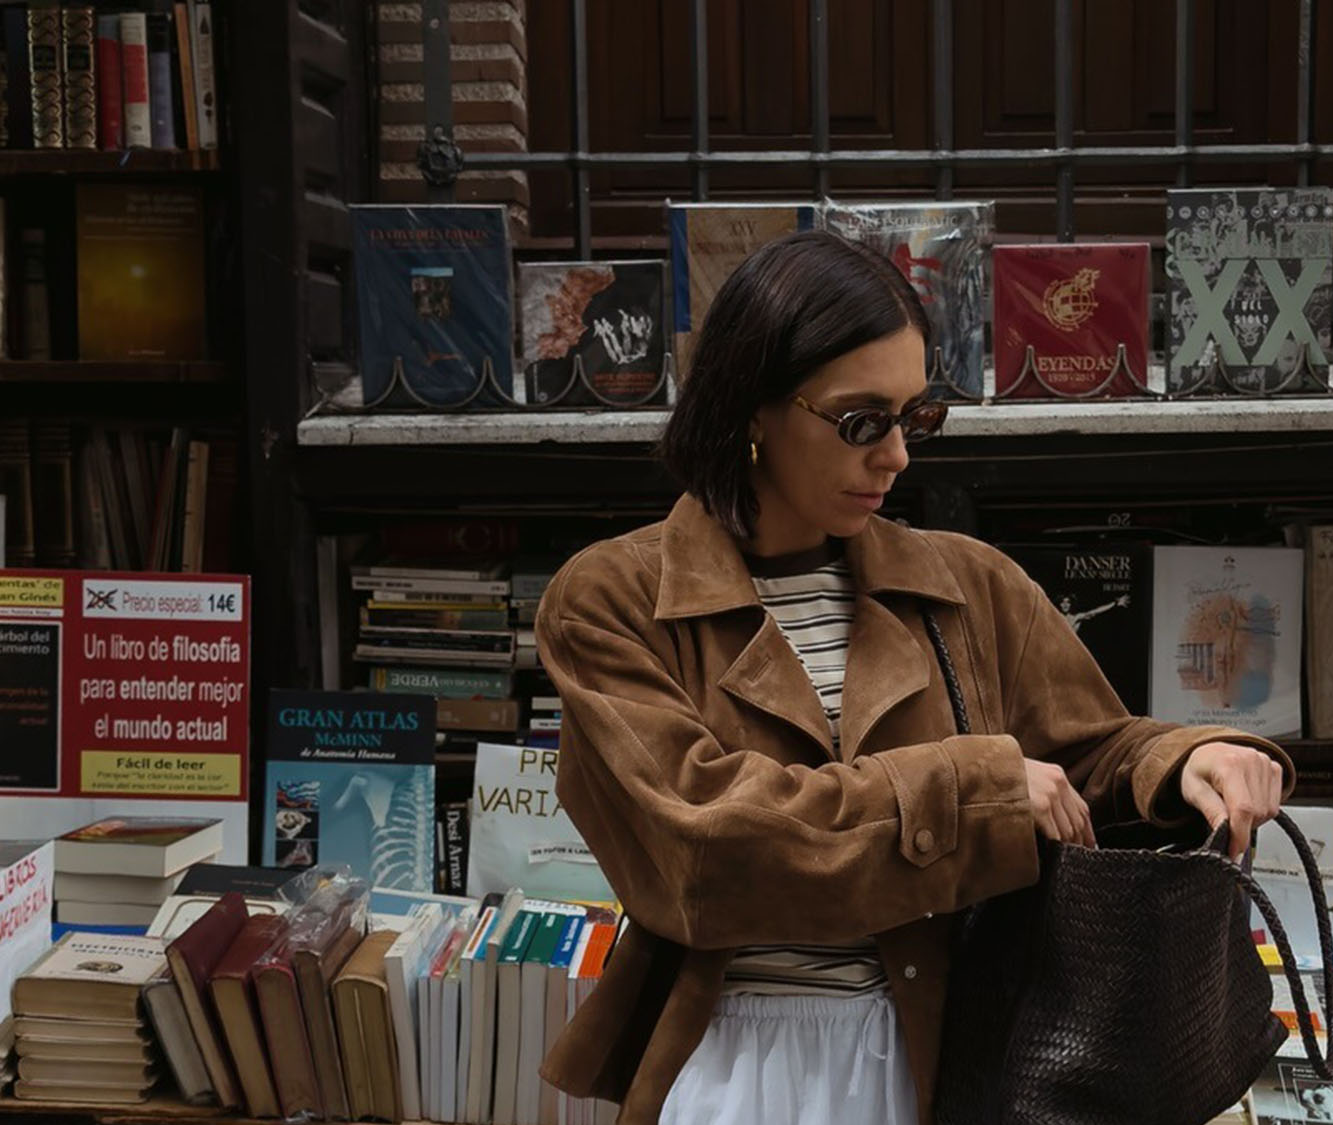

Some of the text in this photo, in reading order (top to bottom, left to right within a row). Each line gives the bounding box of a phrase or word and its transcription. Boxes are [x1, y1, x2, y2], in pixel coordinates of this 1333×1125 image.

[1171, 259, 1329, 367] XX
[1036, 354, 1117, 372] EYENDAS
[1065, 555, 1130, 570] DANSER
[123, 591, 156, 612] Precio
[208, 593, 235, 613] 14€
[84, 633, 241, 663] Un libro de filosofía
[391, 672, 440, 687] VERDE
[80, 675, 244, 708] para entender mejor
[94, 713, 228, 742] el mundo actual
[279, 708, 419, 730] GRAN ATLAS
[315, 732, 383, 747] McMINN
[116, 756, 206, 770] Fácil de leer
[446, 811, 463, 889] Desi Arnaz
